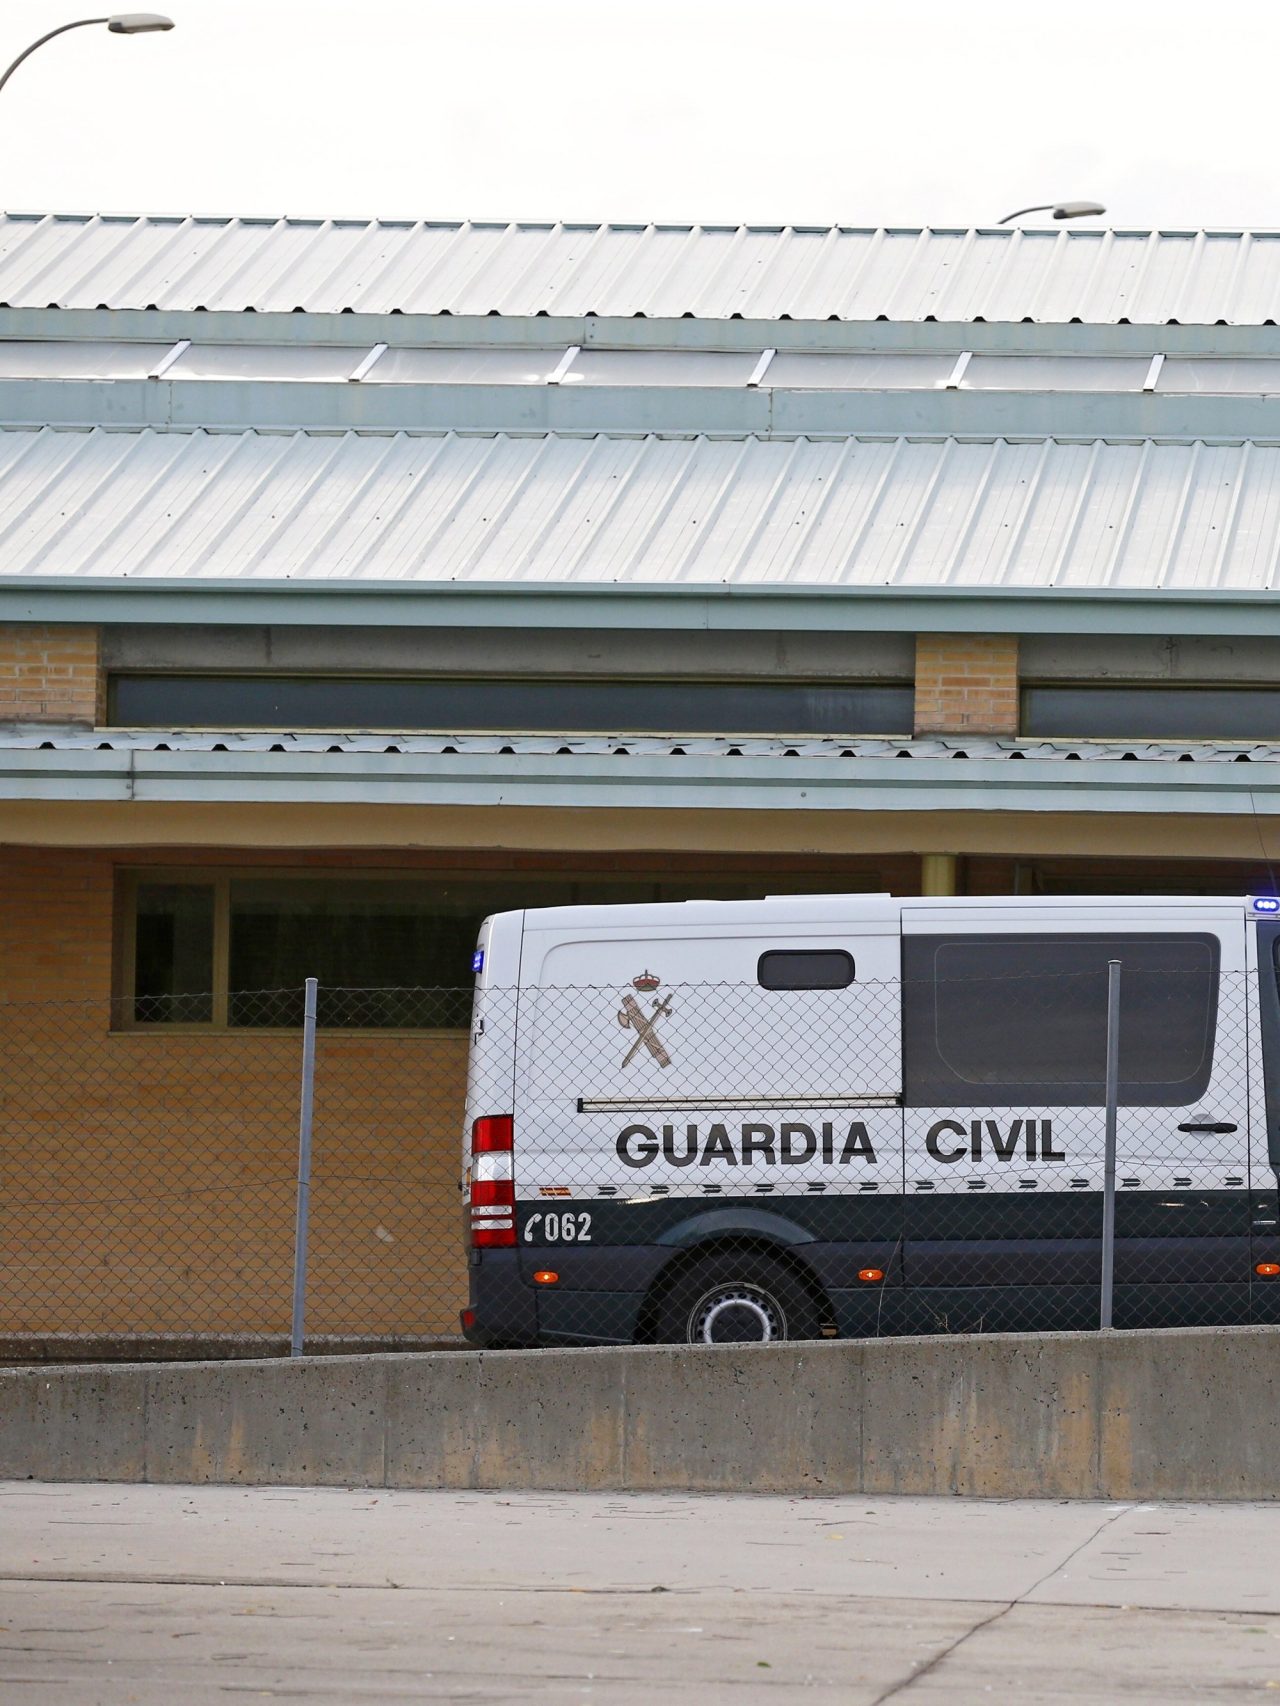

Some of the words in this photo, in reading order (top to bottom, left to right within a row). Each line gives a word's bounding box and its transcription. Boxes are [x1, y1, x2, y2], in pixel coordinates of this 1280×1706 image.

[616, 1121, 878, 1169] GUARDIA
[925, 1119, 1066, 1164] CIVIL
[544, 1212, 592, 1242] 062
